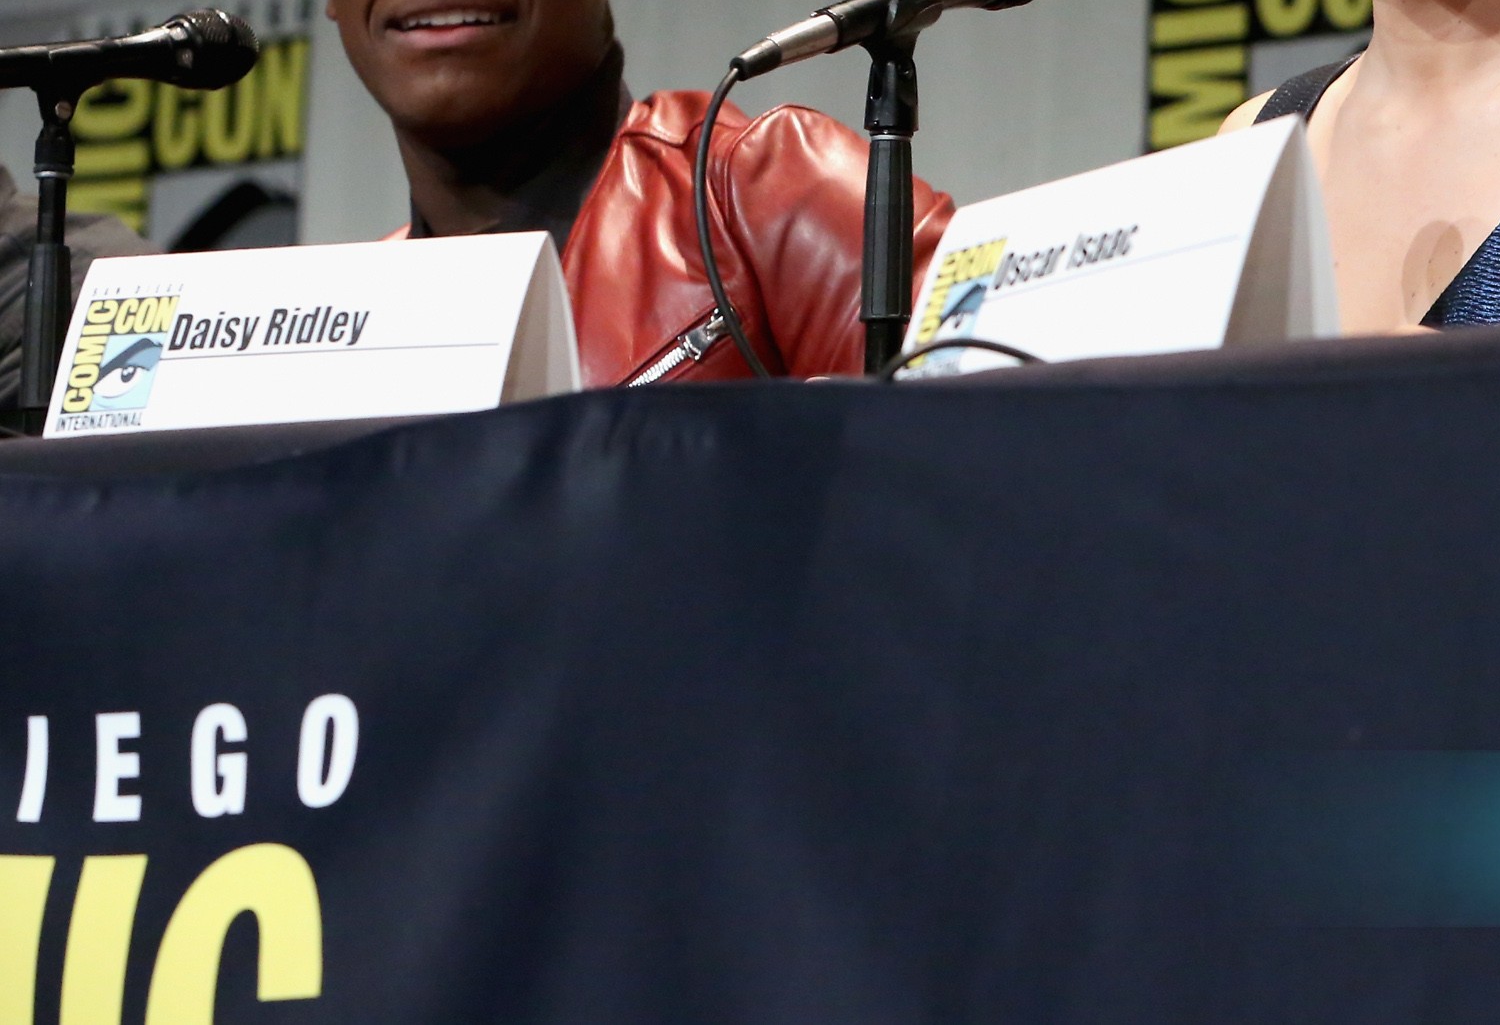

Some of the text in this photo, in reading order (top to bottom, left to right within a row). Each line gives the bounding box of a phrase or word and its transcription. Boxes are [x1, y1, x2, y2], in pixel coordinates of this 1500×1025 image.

[994, 224, 1139, 291] Oscar Isaac
[114, 296, 180, 334] CON
[167, 305, 370, 351] Daisy Ridley
[62, 300, 119, 413] COMIC
[16, 693, 360, 823] IEGO
